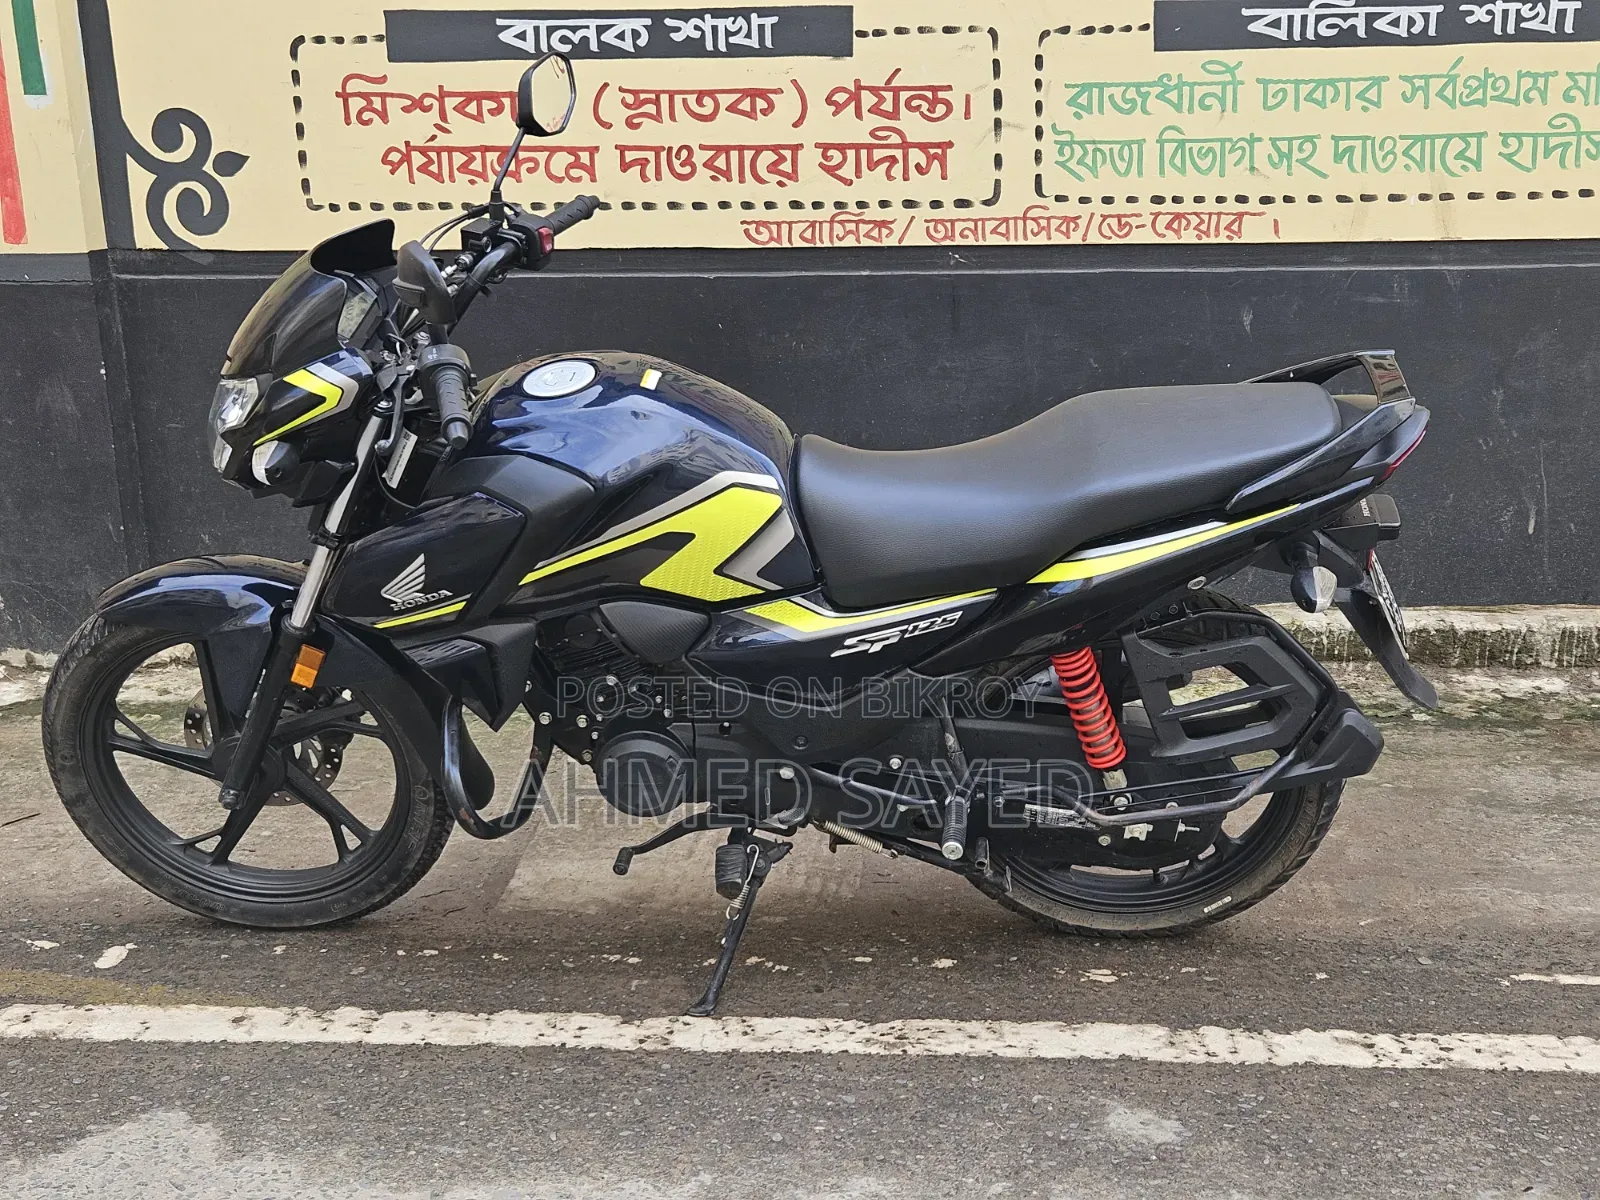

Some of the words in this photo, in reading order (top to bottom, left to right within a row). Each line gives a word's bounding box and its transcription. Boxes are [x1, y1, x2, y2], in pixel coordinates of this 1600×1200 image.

[496, 18, 652, 53] বালক
[664, 13, 779, 52] শাখা
[1241, 0, 1444, 41] বালিকা
[1458, 0, 1583, 36] শাখা
[1064, 60, 1245, 120] রাজধানী
[1256, 72, 1390, 113] ঢাকার
[1399, 56, 1558, 110] সর্বপ্রথম
[615, 144, 804, 187] দাওরায়ে
[814, 126, 954, 186] হাদীস
[1051, 123, 1146, 182] ইফতা
[1156, 125, 1264, 178] বিভাগ
[1268, 133, 1329, 179] সহ
[1331, 131, 1488, 178] দাওরায়ে
[390, 589, 453, 611] HONDA
[830, 625, 908, 657] SP
[904, 611, 963, 638] 125
